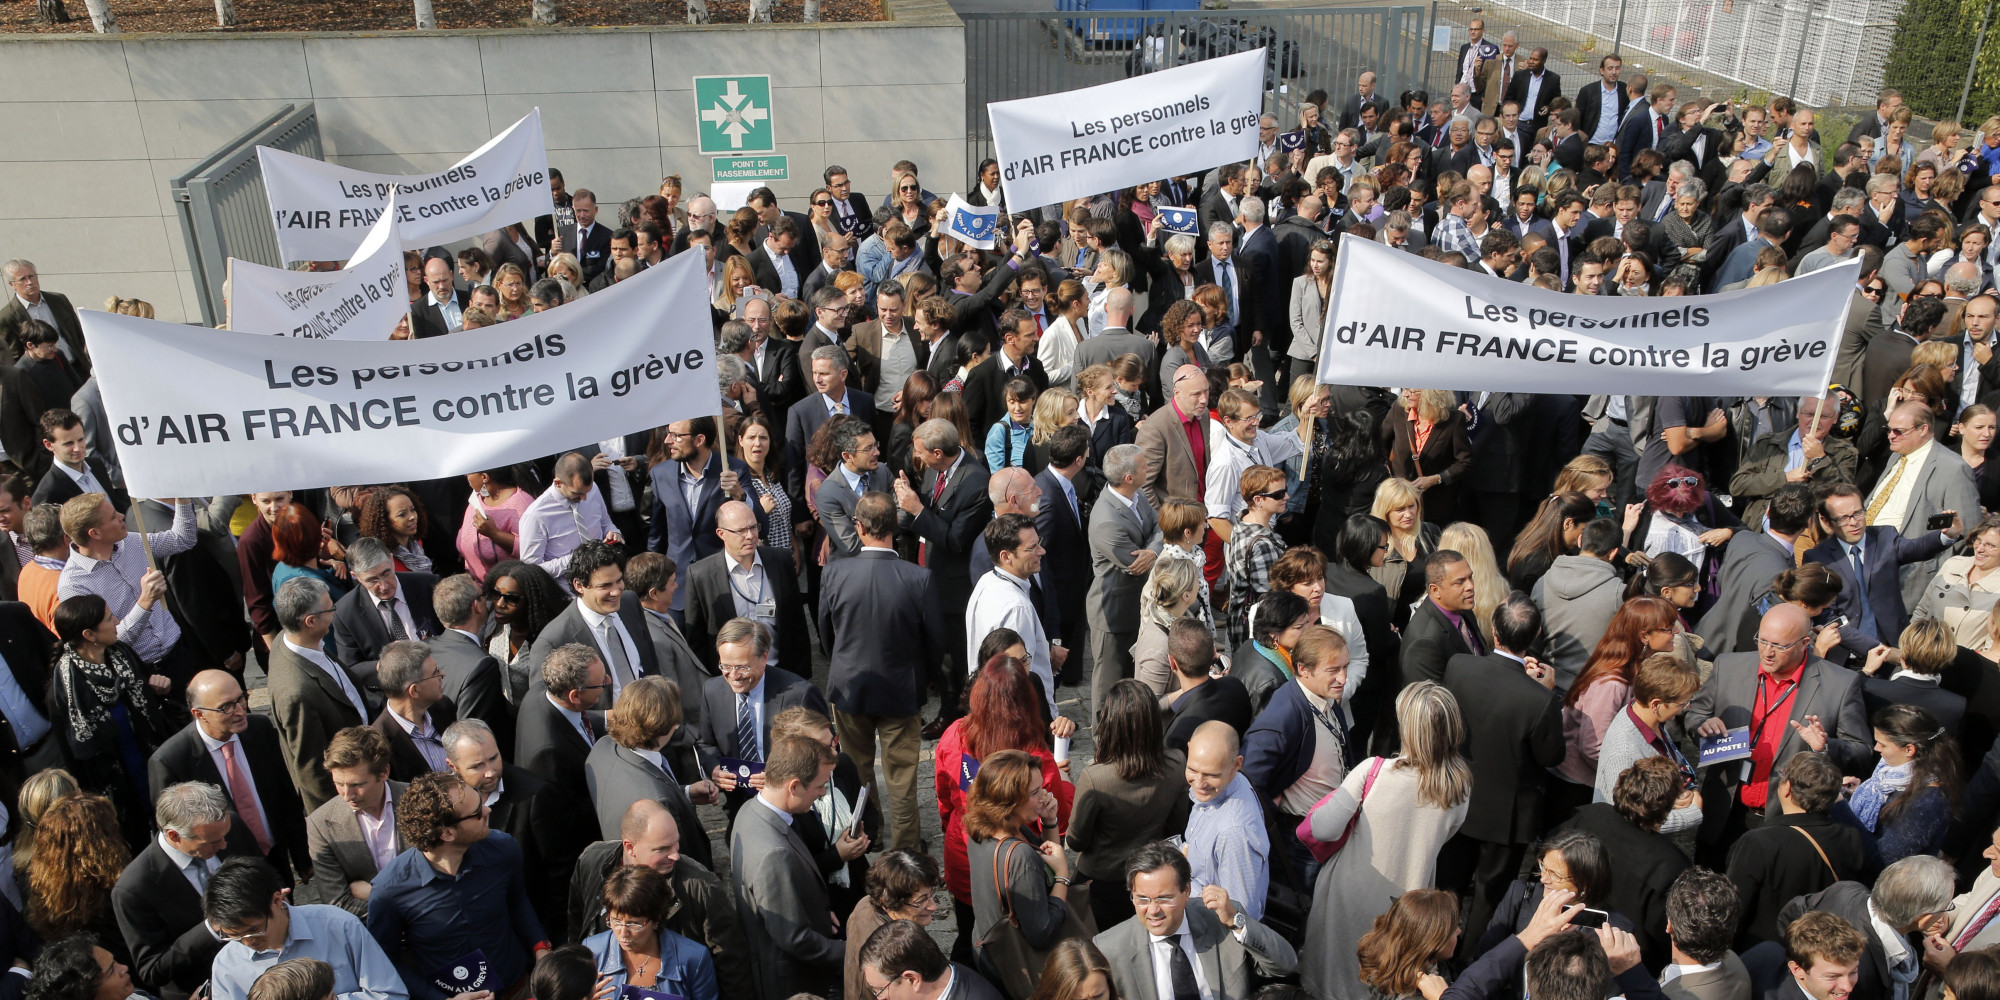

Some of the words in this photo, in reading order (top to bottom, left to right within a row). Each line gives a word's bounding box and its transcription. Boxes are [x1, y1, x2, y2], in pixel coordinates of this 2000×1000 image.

[1071, 120, 1106, 138] Les
[1110, 94, 1210, 134] personnels
[732, 160, 755, 168] POINT
[1004, 154, 1054, 181] d'AIR
[1060, 136, 1143, 169] FRANCE
[1149, 125, 1205, 150] contre
[1210, 119, 1226, 135] la
[717, 168, 784, 178] RASSEMBLEMENT
[339, 180, 373, 199] Les
[418, 194, 479, 218] contre
[480, 185, 500, 204] la
[504, 169, 543, 199] grève
[276, 291, 301, 311] Les
[330, 297, 367, 327] contre
[361, 283, 381, 303] la
[1465, 296, 1518, 323] Les
[1529, 305, 1710, 329] personnels
[1336, 321, 1425, 352] d'AIR
[1435, 331, 1578, 364] FRANCE
[1589, 345, 1690, 368] contre
[1702, 343, 1729, 368] la
[1740, 339, 1827, 371] grève
[264, 359, 339, 390] Les
[352, 333, 566, 390] personnels
[117, 412, 231, 446] d'AIR
[242, 395, 421, 441] FRANCE
[432, 383, 555, 422] contre
[565, 371, 600, 402] la
[611, 348, 704, 397] grève
[1703, 748, 1715, 756] AU
[1716, 742, 1742, 753] POSTE
[1716, 736, 1733, 745] PNT
[962, 761, 971, 779] NON
[435, 979, 454, 992] NON
[462, 985, 474, 993] LA
[473, 965, 487, 988] GREVE
